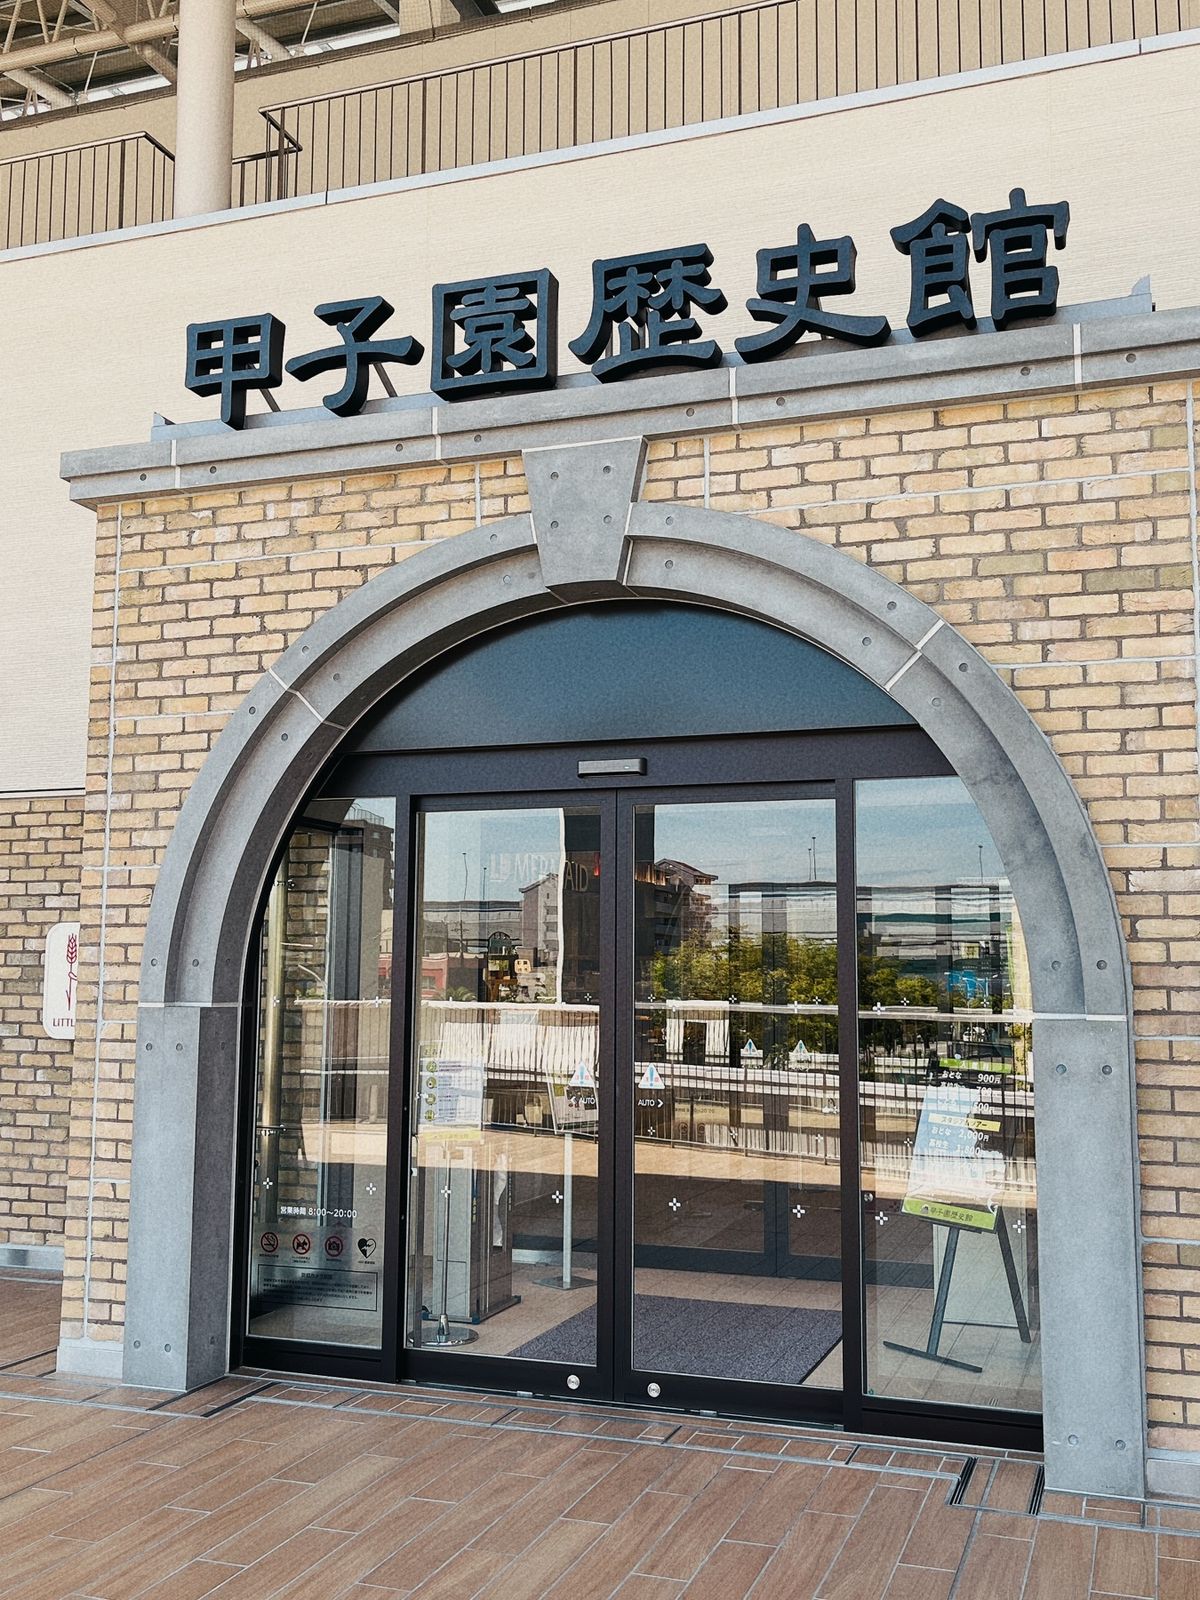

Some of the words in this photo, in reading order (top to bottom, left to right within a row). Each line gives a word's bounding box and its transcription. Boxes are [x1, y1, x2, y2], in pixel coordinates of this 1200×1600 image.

[185, 187, 1069, 430] 甲子園歴史館
[941, 1070, 962, 1080] おとな
[977, 1073, 1001, 1084] 900円
[579, 1097, 596, 1105] AUTO
[637, 1099, 656, 1107] AUTO
